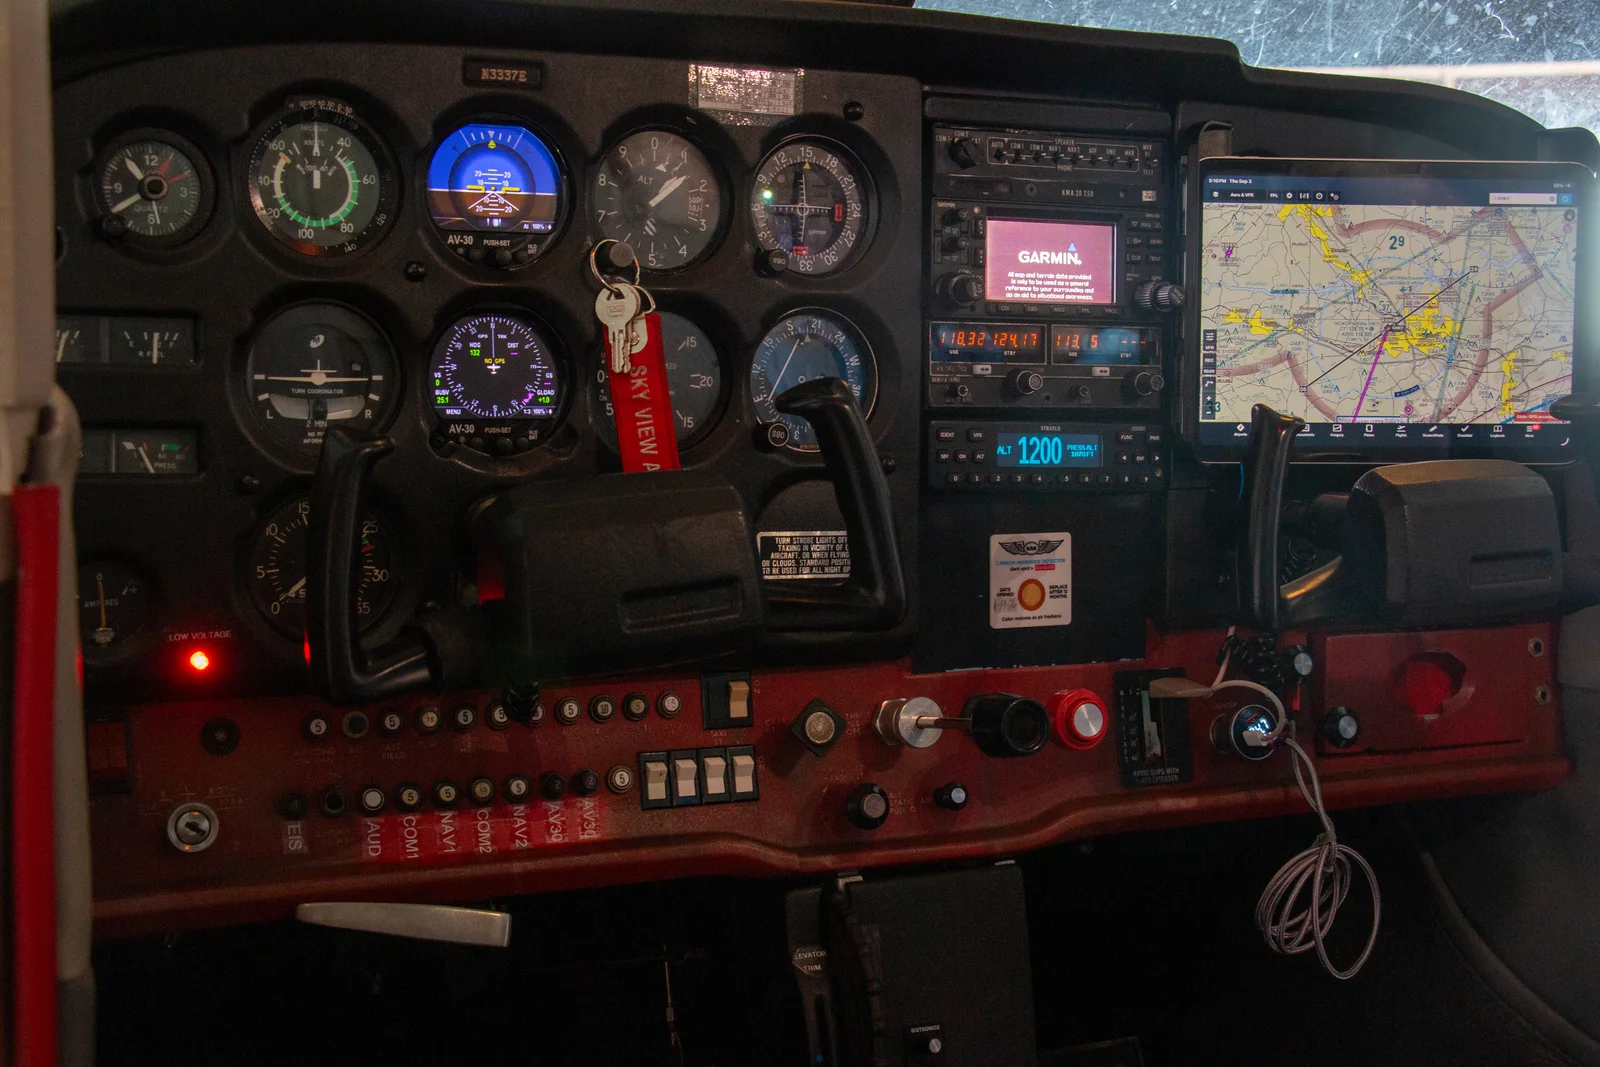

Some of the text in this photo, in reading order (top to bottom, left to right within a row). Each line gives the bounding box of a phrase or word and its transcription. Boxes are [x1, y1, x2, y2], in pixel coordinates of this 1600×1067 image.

[481, 68, 527, 82] N3337E
[269, 140, 285, 150] 160
[337, 138, 351, 147] 40
[773, 152, 787, 165] 12
[800, 146, 813, 157] 15
[144, 155, 159, 166] 12
[362, 175, 375, 184] 60
[638, 175, 654, 185] ALT
[844, 175, 857, 189] 21
[852, 203, 861, 218] 24
[298, 229, 313, 239] 100
[447, 235, 473, 245] AV-30
[1389, 235, 1405, 250] 29
[824, 251, 838, 265] 30
[941, 331, 1037, 348] 118.32 124.17
[629, 365, 650, 400] SKY
[700, 375, 713, 387] 20
[313, 420, 328, 428] MIN
[449, 424, 475, 434] AV-30
[634, 407, 658, 455] VIEW
[997, 446, 1012, 455] ALT
[1018, 436, 1062, 464] 1200
[372, 569, 389, 582] 30
[168, 630, 232, 641] LOW VOLTAGE
[545, 802, 563, 842] AV30
[582, 799, 596, 838] AV30
[440, 812, 456, 853] NAV1
[477, 810, 492, 854] COM2
[513, 806, 528, 848] NAV2
[287, 824, 302, 850] EIS
[367, 821, 382, 856] AUD
[403, 816, 419, 859] COM1
